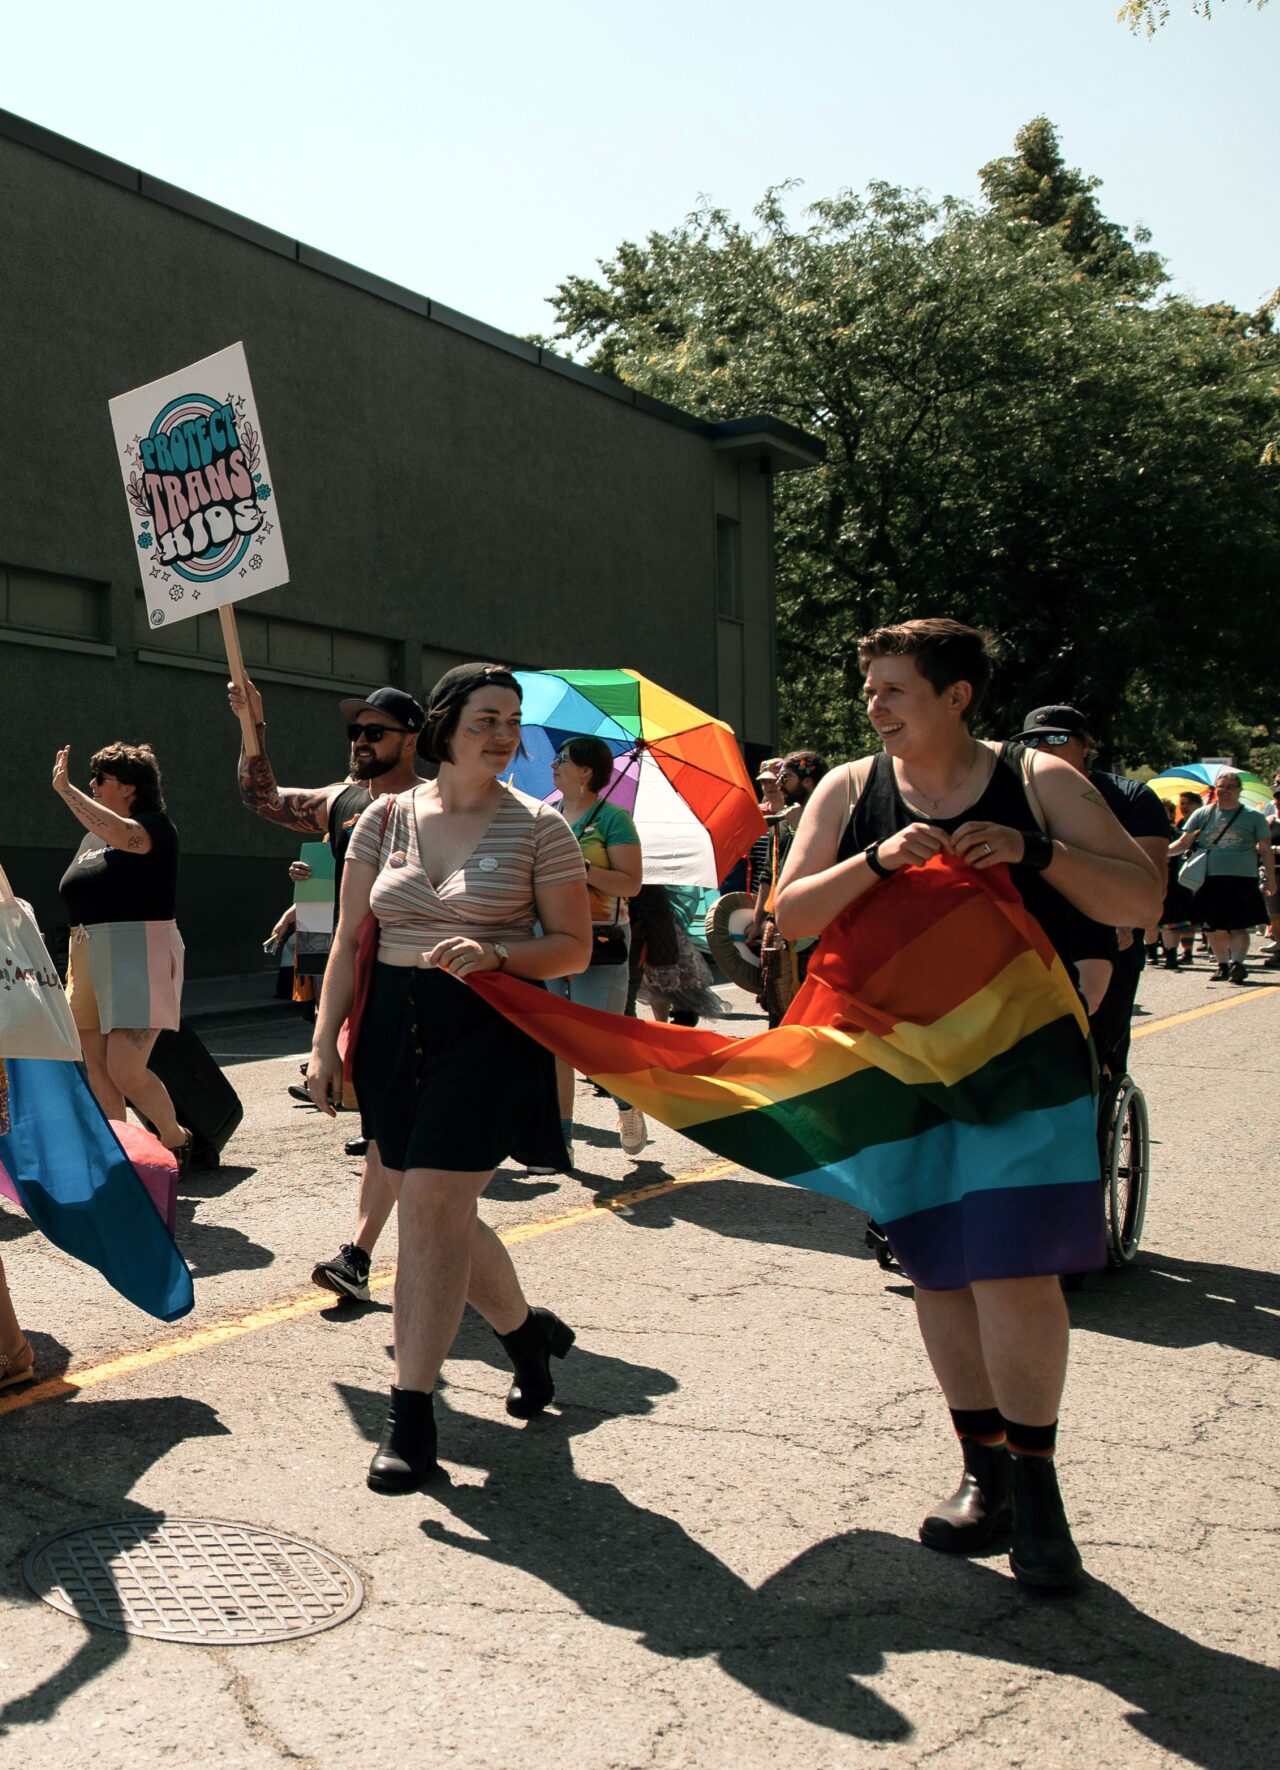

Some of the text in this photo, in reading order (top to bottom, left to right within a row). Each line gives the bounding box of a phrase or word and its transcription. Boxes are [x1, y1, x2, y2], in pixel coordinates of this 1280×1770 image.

[140, 404, 241, 471] PROTECT
[145, 449, 253, 535] TRANS
[160, 498, 263, 562] KIDS
